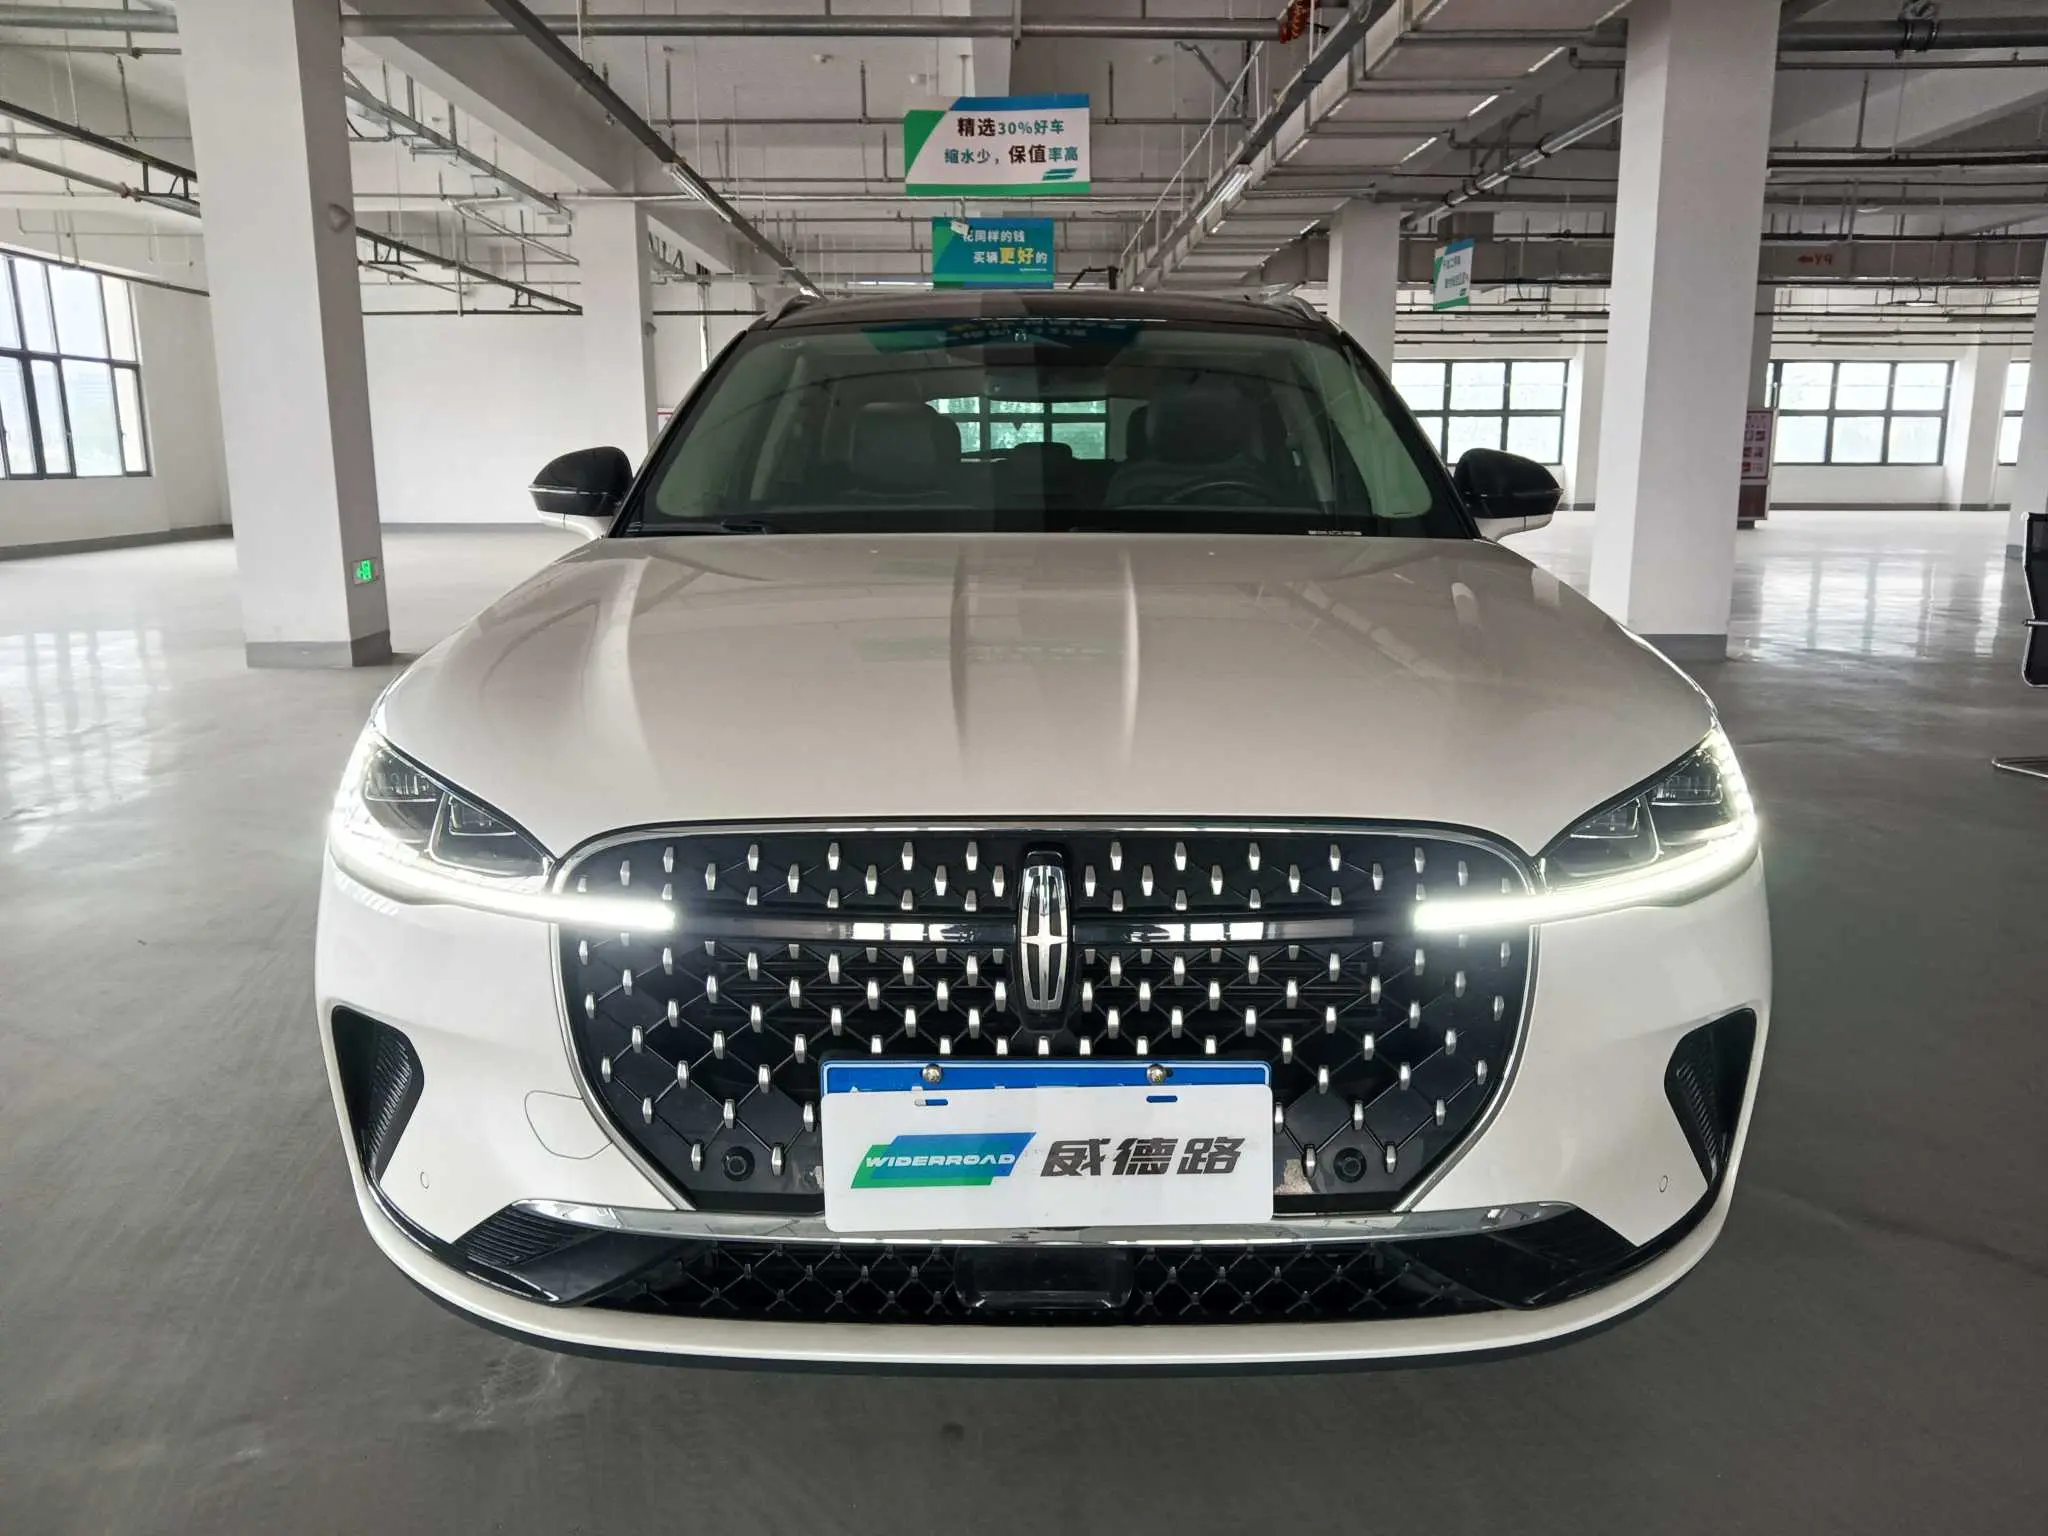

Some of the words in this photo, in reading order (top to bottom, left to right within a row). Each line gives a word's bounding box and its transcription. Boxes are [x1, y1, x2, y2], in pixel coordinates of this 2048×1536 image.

[957, 117, 1064, 137] 精选30%好车
[973, 247, 1048, 265] 买辆更好的
[866, 1153, 1015, 1167] WIDERROAD
[1040, 1137, 1245, 1176] 威德路
